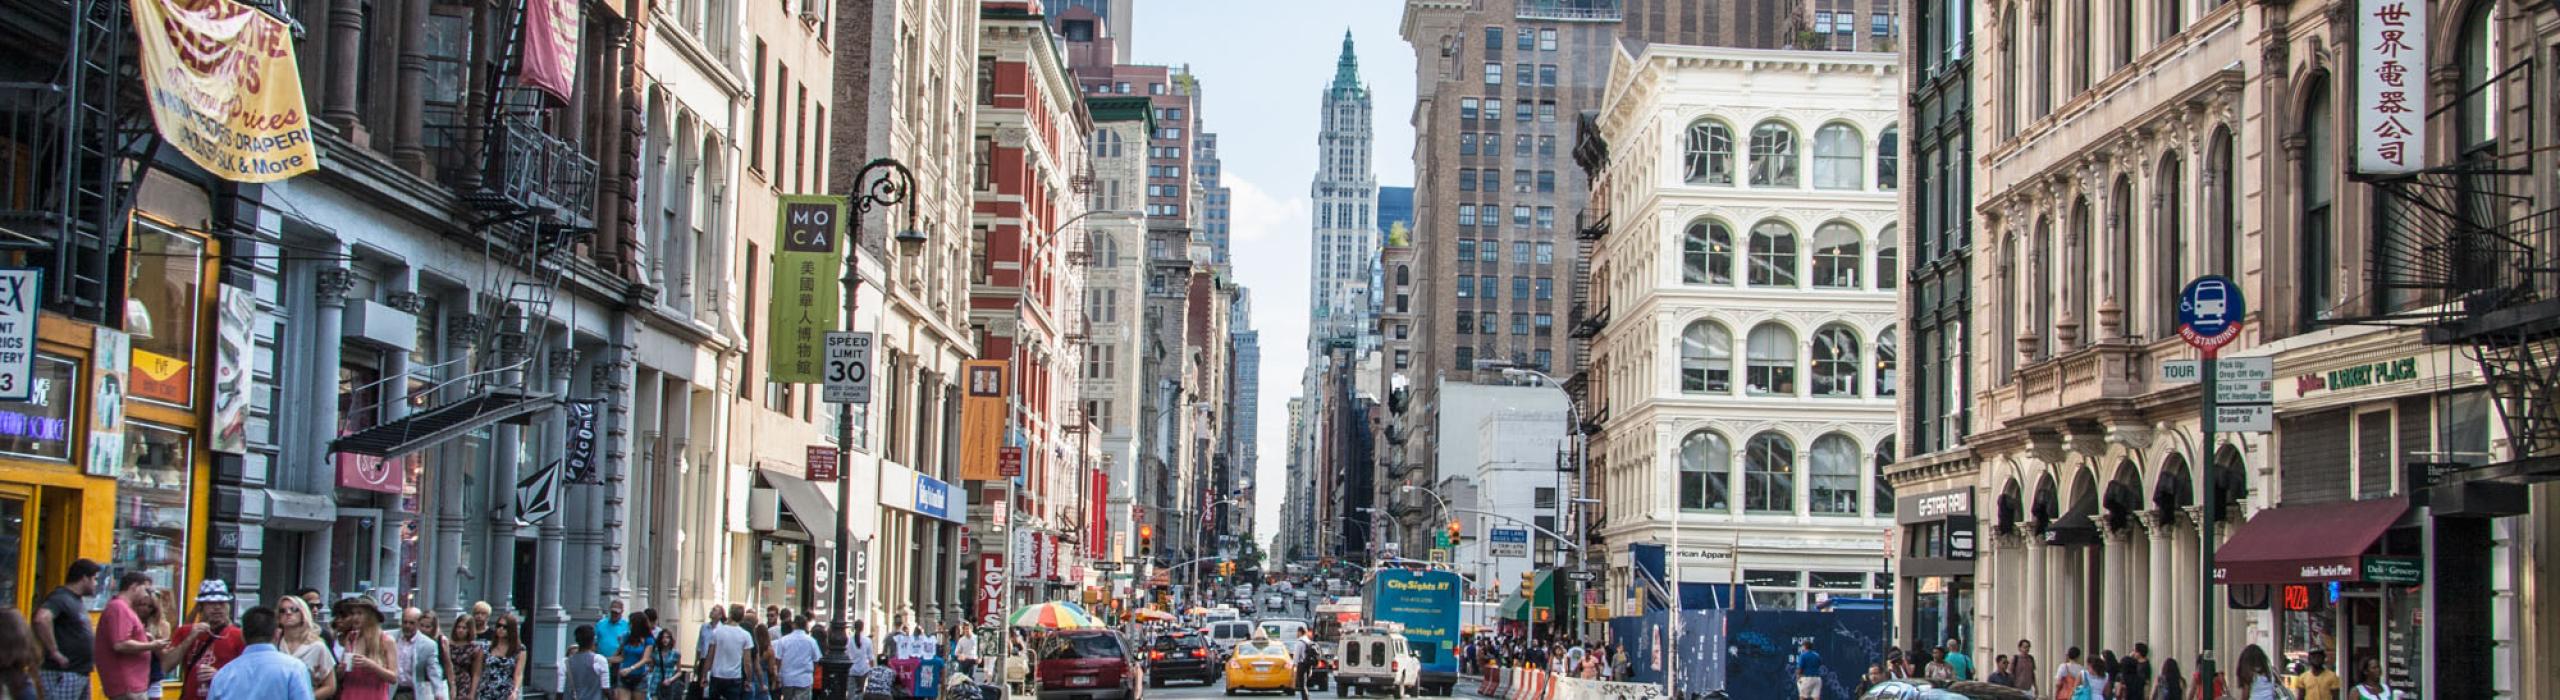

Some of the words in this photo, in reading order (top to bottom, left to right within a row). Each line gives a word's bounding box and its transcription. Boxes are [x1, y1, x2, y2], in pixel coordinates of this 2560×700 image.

[2373, 3, 2413, 166] 世界電器公司
[252, 154, 304, 174] More
[829, 338, 869, 346] SPEED
[2182, 326, 2194, 340] NO
[2194, 325, 2238, 346] STANDING
[832, 349, 864, 358] LIMIT
[829, 361, 865, 382] 30
[2164, 365, 2195, 378] TOUR
[2219, 370, 2235, 379] Drop
[1, 373, 13, 391] 3
[2219, 407, 2254, 416] Broadway
[1919, 496, 1947, 516] G-STAR
[1948, 492, 1967, 512] RAW
[1701, 549, 1733, 559] Apparel
[2367, 565, 2384, 573] Deli
[2389, 566, 2421, 577] Grocery
[1387, 579, 1436, 591] CitySights
[2284, 585, 2309, 610] PIZZA
